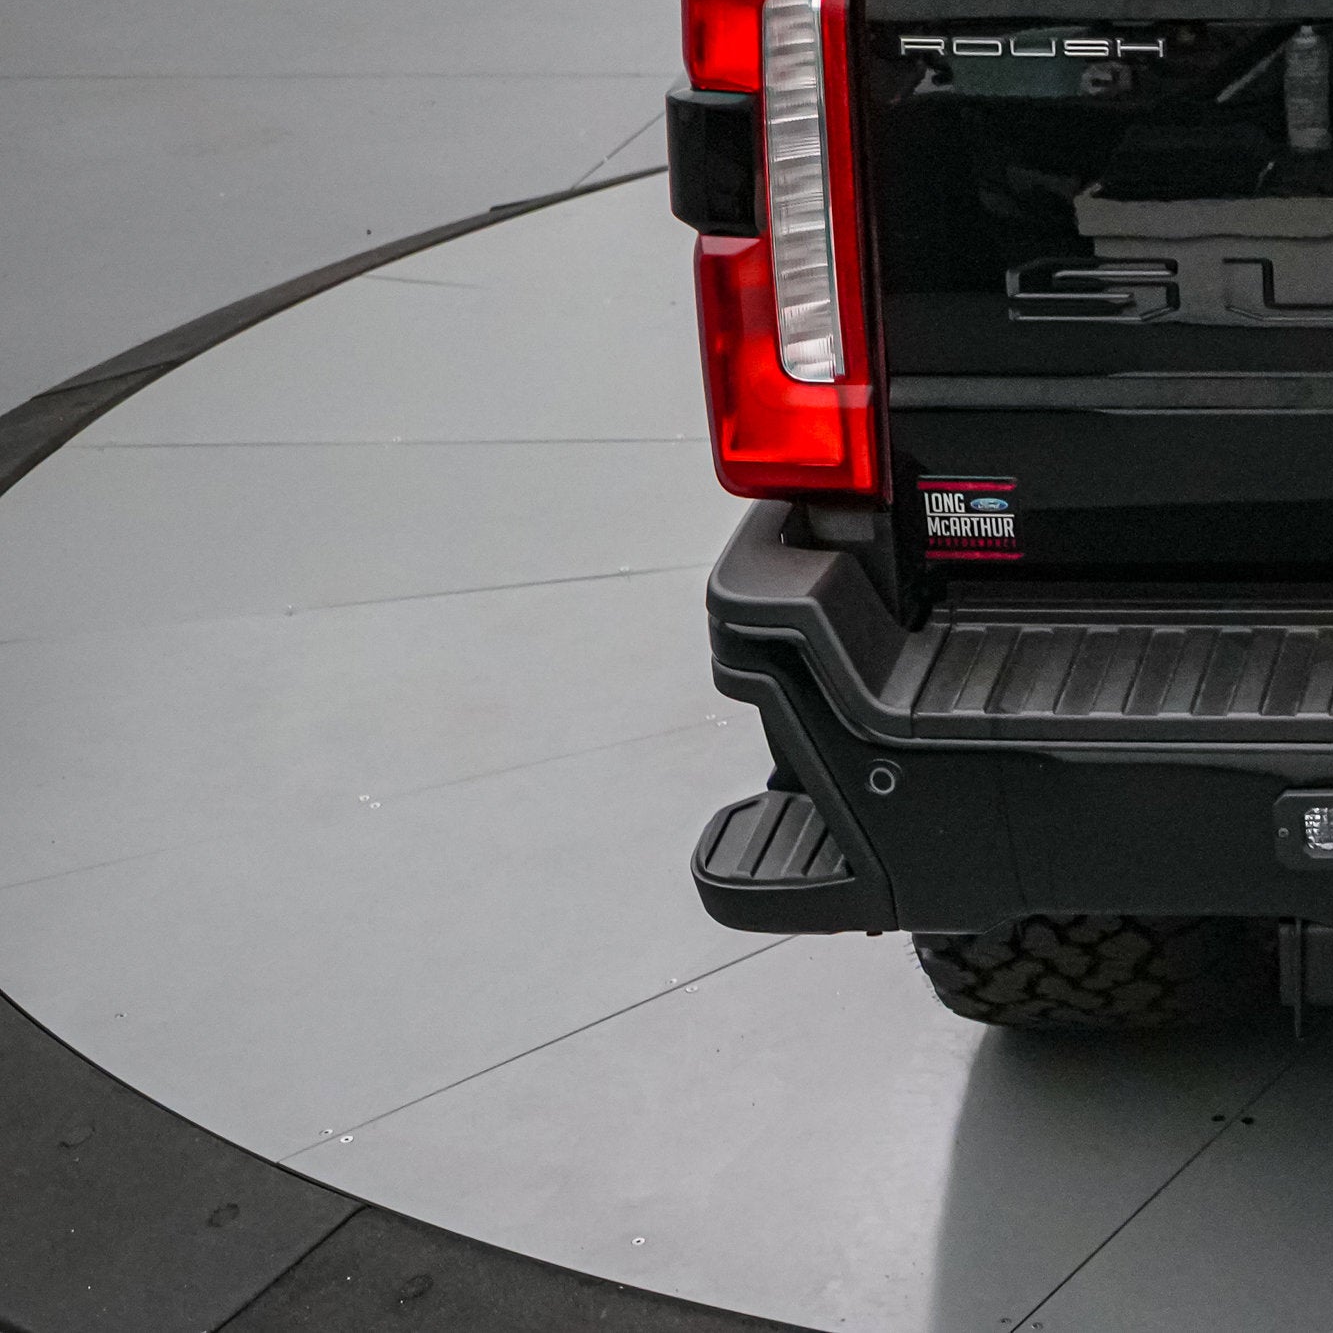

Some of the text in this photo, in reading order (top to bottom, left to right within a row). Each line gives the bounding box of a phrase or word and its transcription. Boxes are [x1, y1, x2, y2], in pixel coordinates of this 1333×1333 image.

[900, 37, 1165, 58] ROUSH
[924, 492, 966, 517] LONG
[927, 517, 1015, 538] McARTHUR
